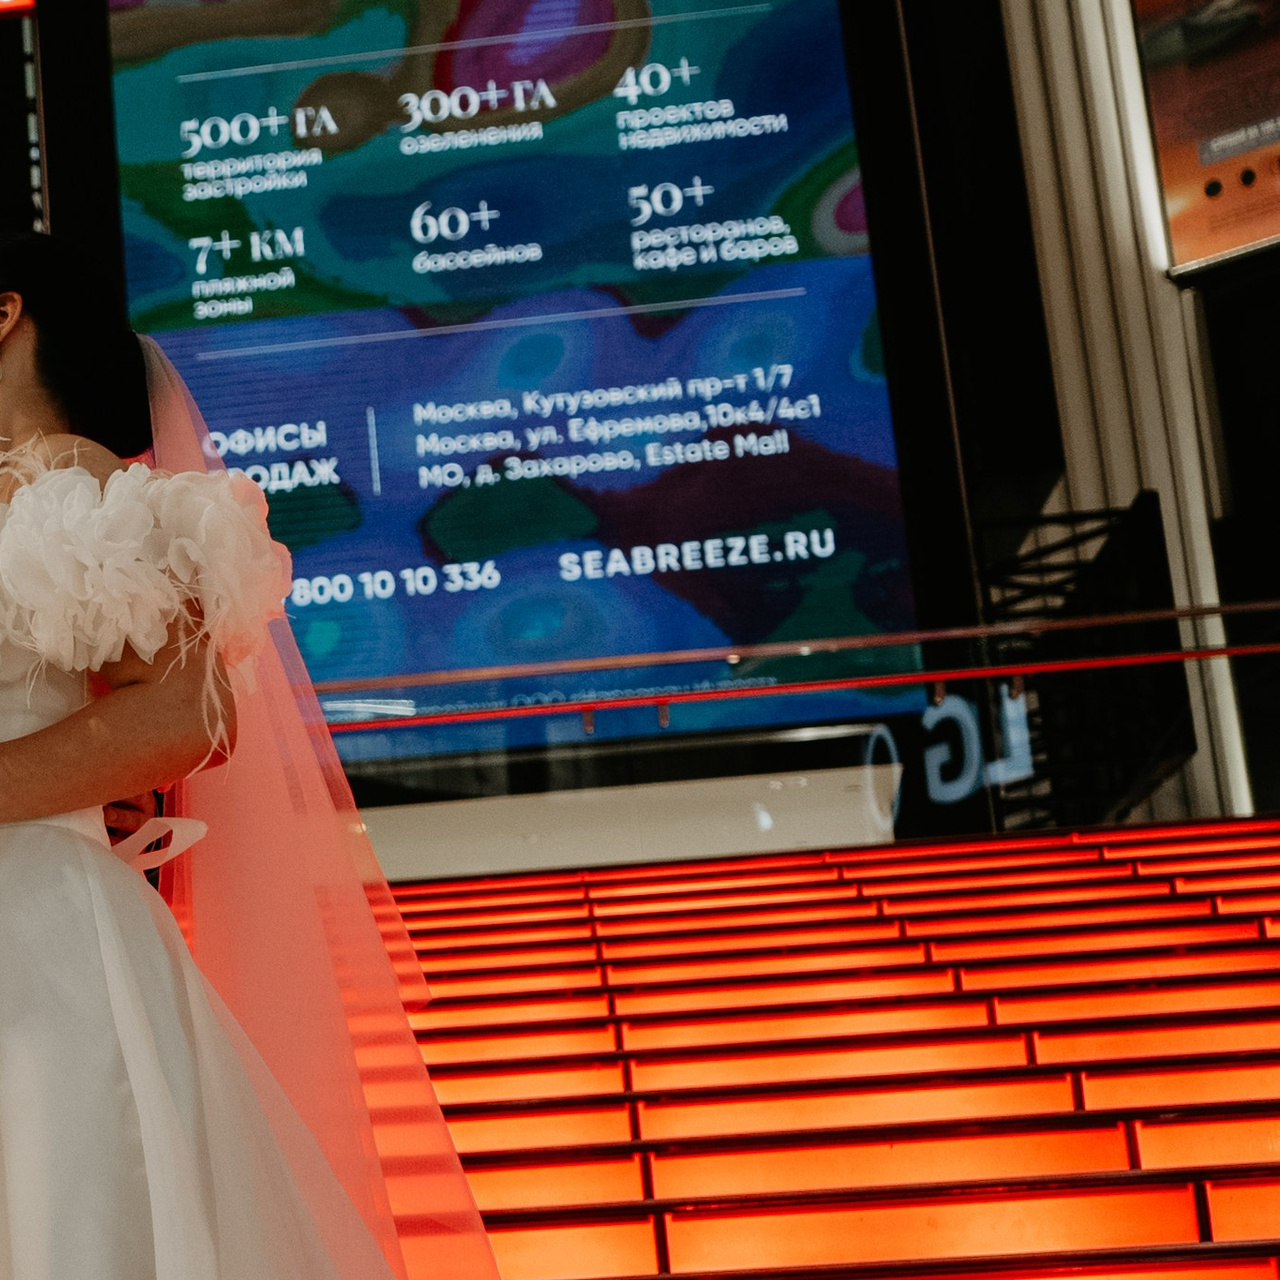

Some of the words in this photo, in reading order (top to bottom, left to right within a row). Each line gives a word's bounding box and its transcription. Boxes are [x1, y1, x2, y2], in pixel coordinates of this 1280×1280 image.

[613, 56, 701, 105] 40+
[397, 79, 509, 133] 300+
[616, 99, 735, 130] проектов
[179, 106, 289, 159] 500+
[399, 121, 543, 155] озеленения
[618, 113, 789, 150] недвижимости
[180, 147, 323, 181] территория
[182, 170, 308, 201] застройки
[628, 175, 715, 227] 50+
[410, 200, 501, 244] 60+
[188, 229, 242, 275] 7+
[412, 243, 543, 274] бассейнов
[633, 244, 697, 272] кафе
[699, 242, 718, 264] и
[721, 234, 799, 262] баров
[192, 266, 295, 299] пляжной
[193, 296, 254, 320] зоны
[413, 399, 518, 426] Москва,
[522, 377, 683, 418] Кутузовский
[686, 373, 749, 401] пр-т
[751, 364, 794, 392] 1/7
[202, 421, 327, 459] ОФИСЫ
[416, 430, 521, 457] Москва,
[524, 425, 564, 451] ул.
[418, 462, 471, 489] МО,
[504, 450, 641, 482] Захарово,
[645, 438, 730, 467] Estate
[733, 428, 791, 458] Mall
[558, 528, 836, 583] SEABREEZE.RU
[291, 574, 354, 607] 800
[358, 570, 396, 600] 10
[400, 565, 438, 597] 10
[443, 560, 502, 594] 336
